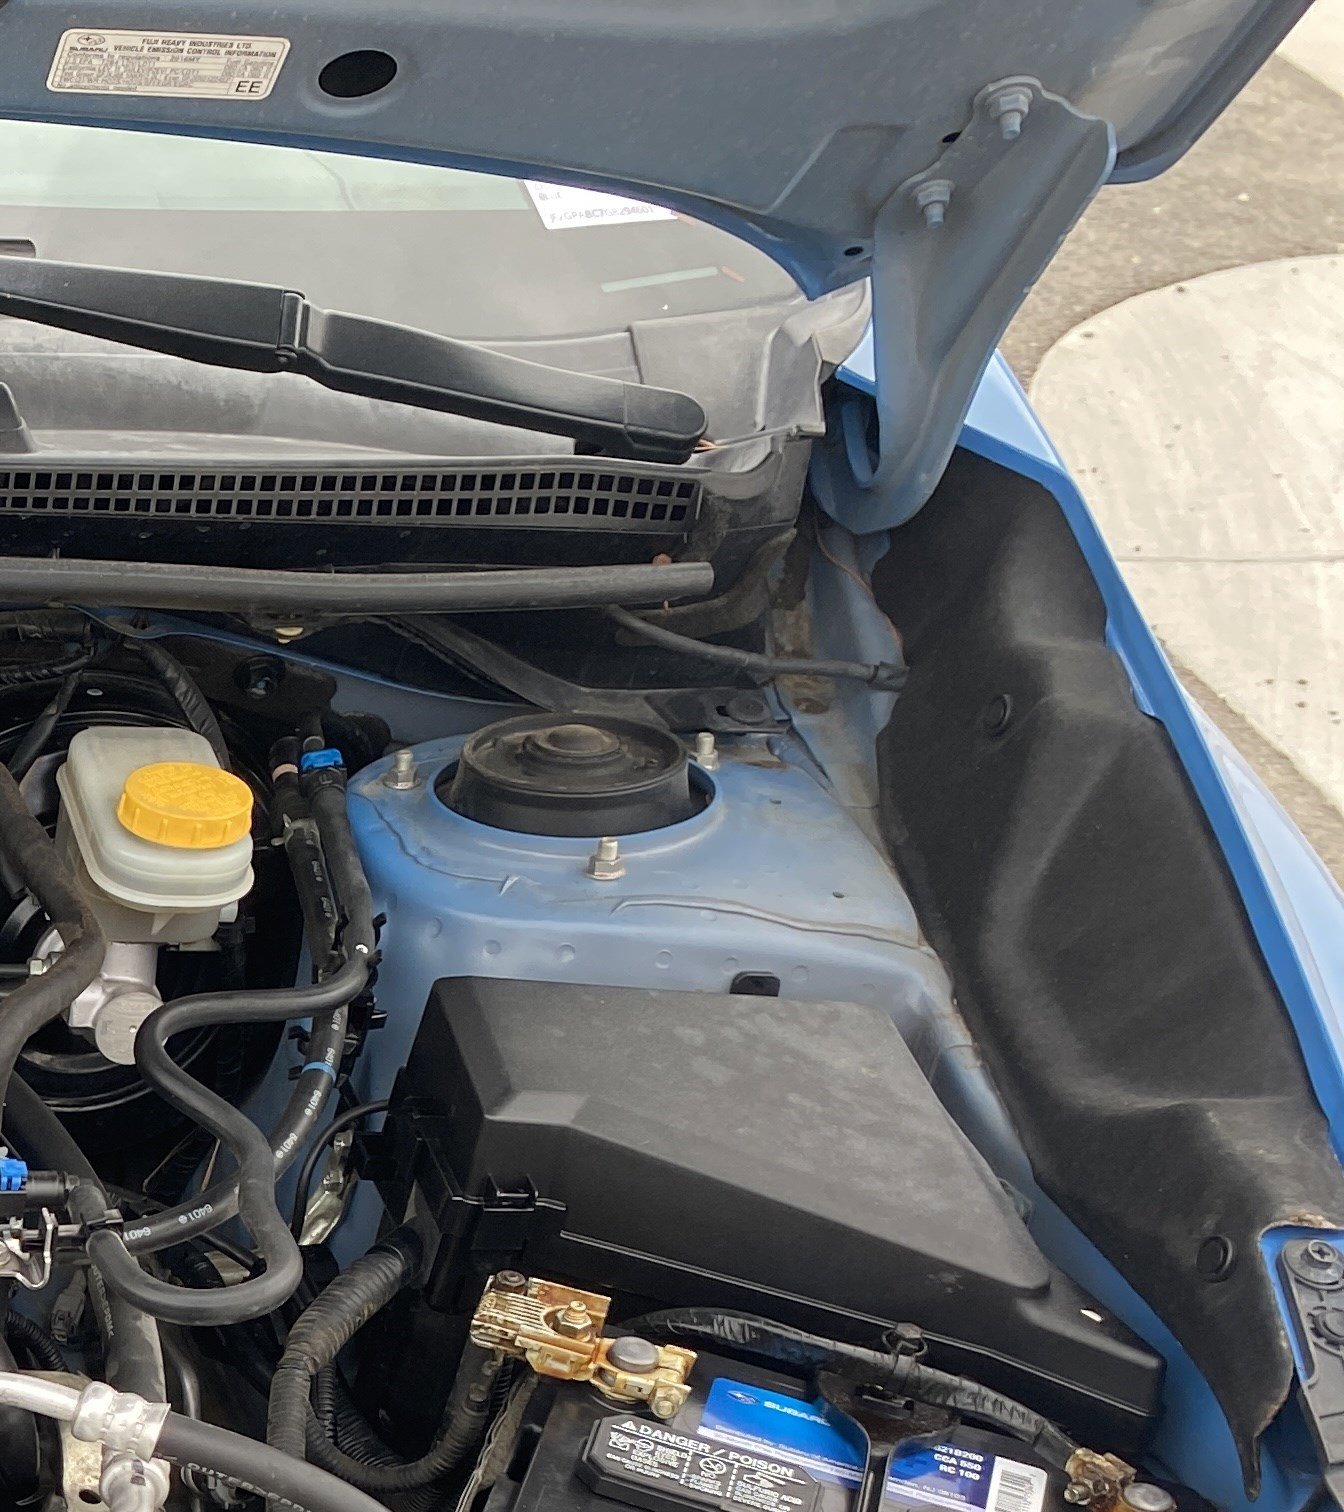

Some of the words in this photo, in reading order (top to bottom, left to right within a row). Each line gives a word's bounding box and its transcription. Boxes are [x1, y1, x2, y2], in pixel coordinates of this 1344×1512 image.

[113, 44, 145, 53] VEHICLE
[147, 46, 184, 54] EMISSION
[186, 48, 221, 56] CONTROL
[224, 50, 277, 58] INFORMATION
[189, 40, 234, 49] INDUSTRIES
[235, 81, 263, 94] EE
[187, 1203, 214, 1221] 6401
[640, 1424, 711, 1454] DANGER
[729, 1451, 795, 1477] POISON
[933, 1453, 957, 1466] CCA
[700, 1470, 717, 1479] NO
[939, 1463, 957, 1475] RC
[958, 1469, 980, 1481] 100
[780, 1494, 803, 1506] ACID
